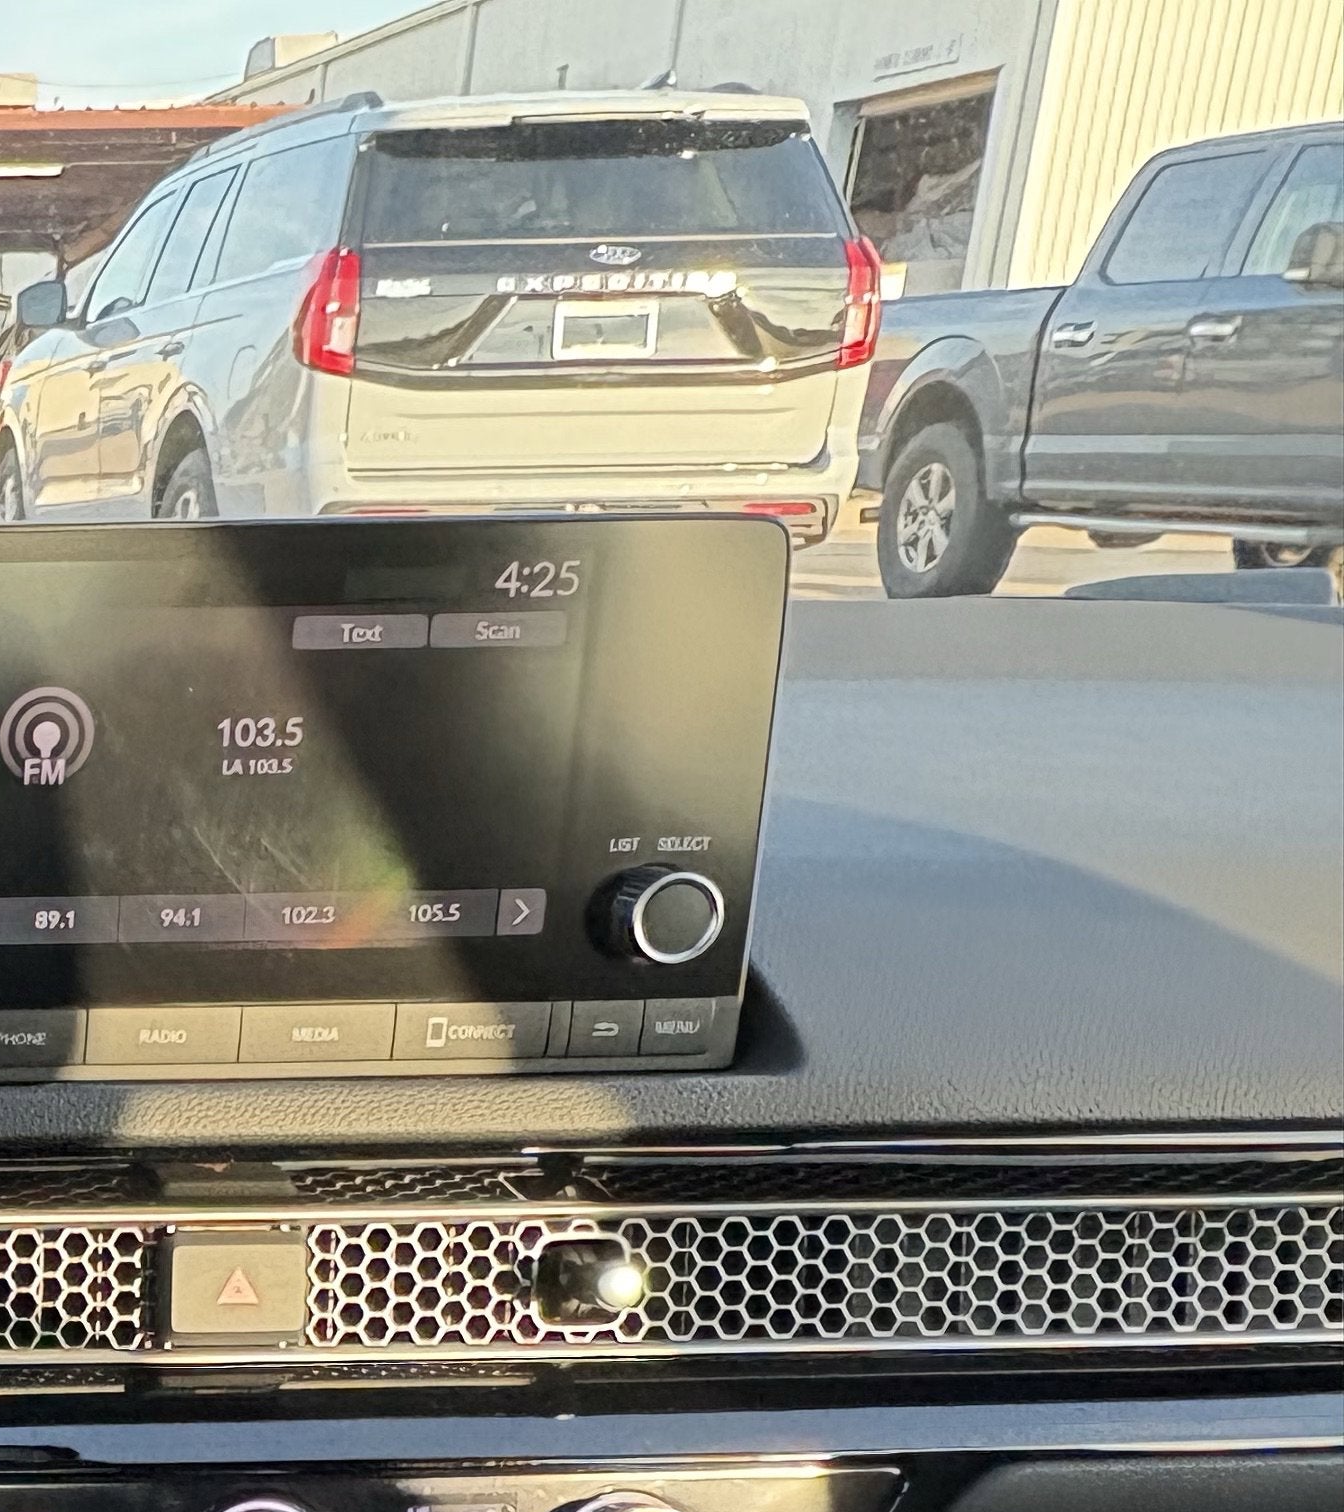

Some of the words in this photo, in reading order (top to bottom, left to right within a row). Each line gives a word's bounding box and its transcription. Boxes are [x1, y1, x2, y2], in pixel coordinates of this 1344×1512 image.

[494, 559, 581, 598] 4:25
[340, 622, 384, 643] Text
[474, 620, 521, 641] Scan
[216, 716, 304, 748] 103.5
[22, 757, 67, 786] FM
[221, 759, 243, 776] LA
[249, 757, 294, 775] 103.5
[34, 910, 75, 930] 89.1
[160, 907, 201, 928] 94.1
[280, 905, 337, 925] 102.3
[408, 903, 461, 923] 105.5
[139, 1029, 187, 1044] RADIO
